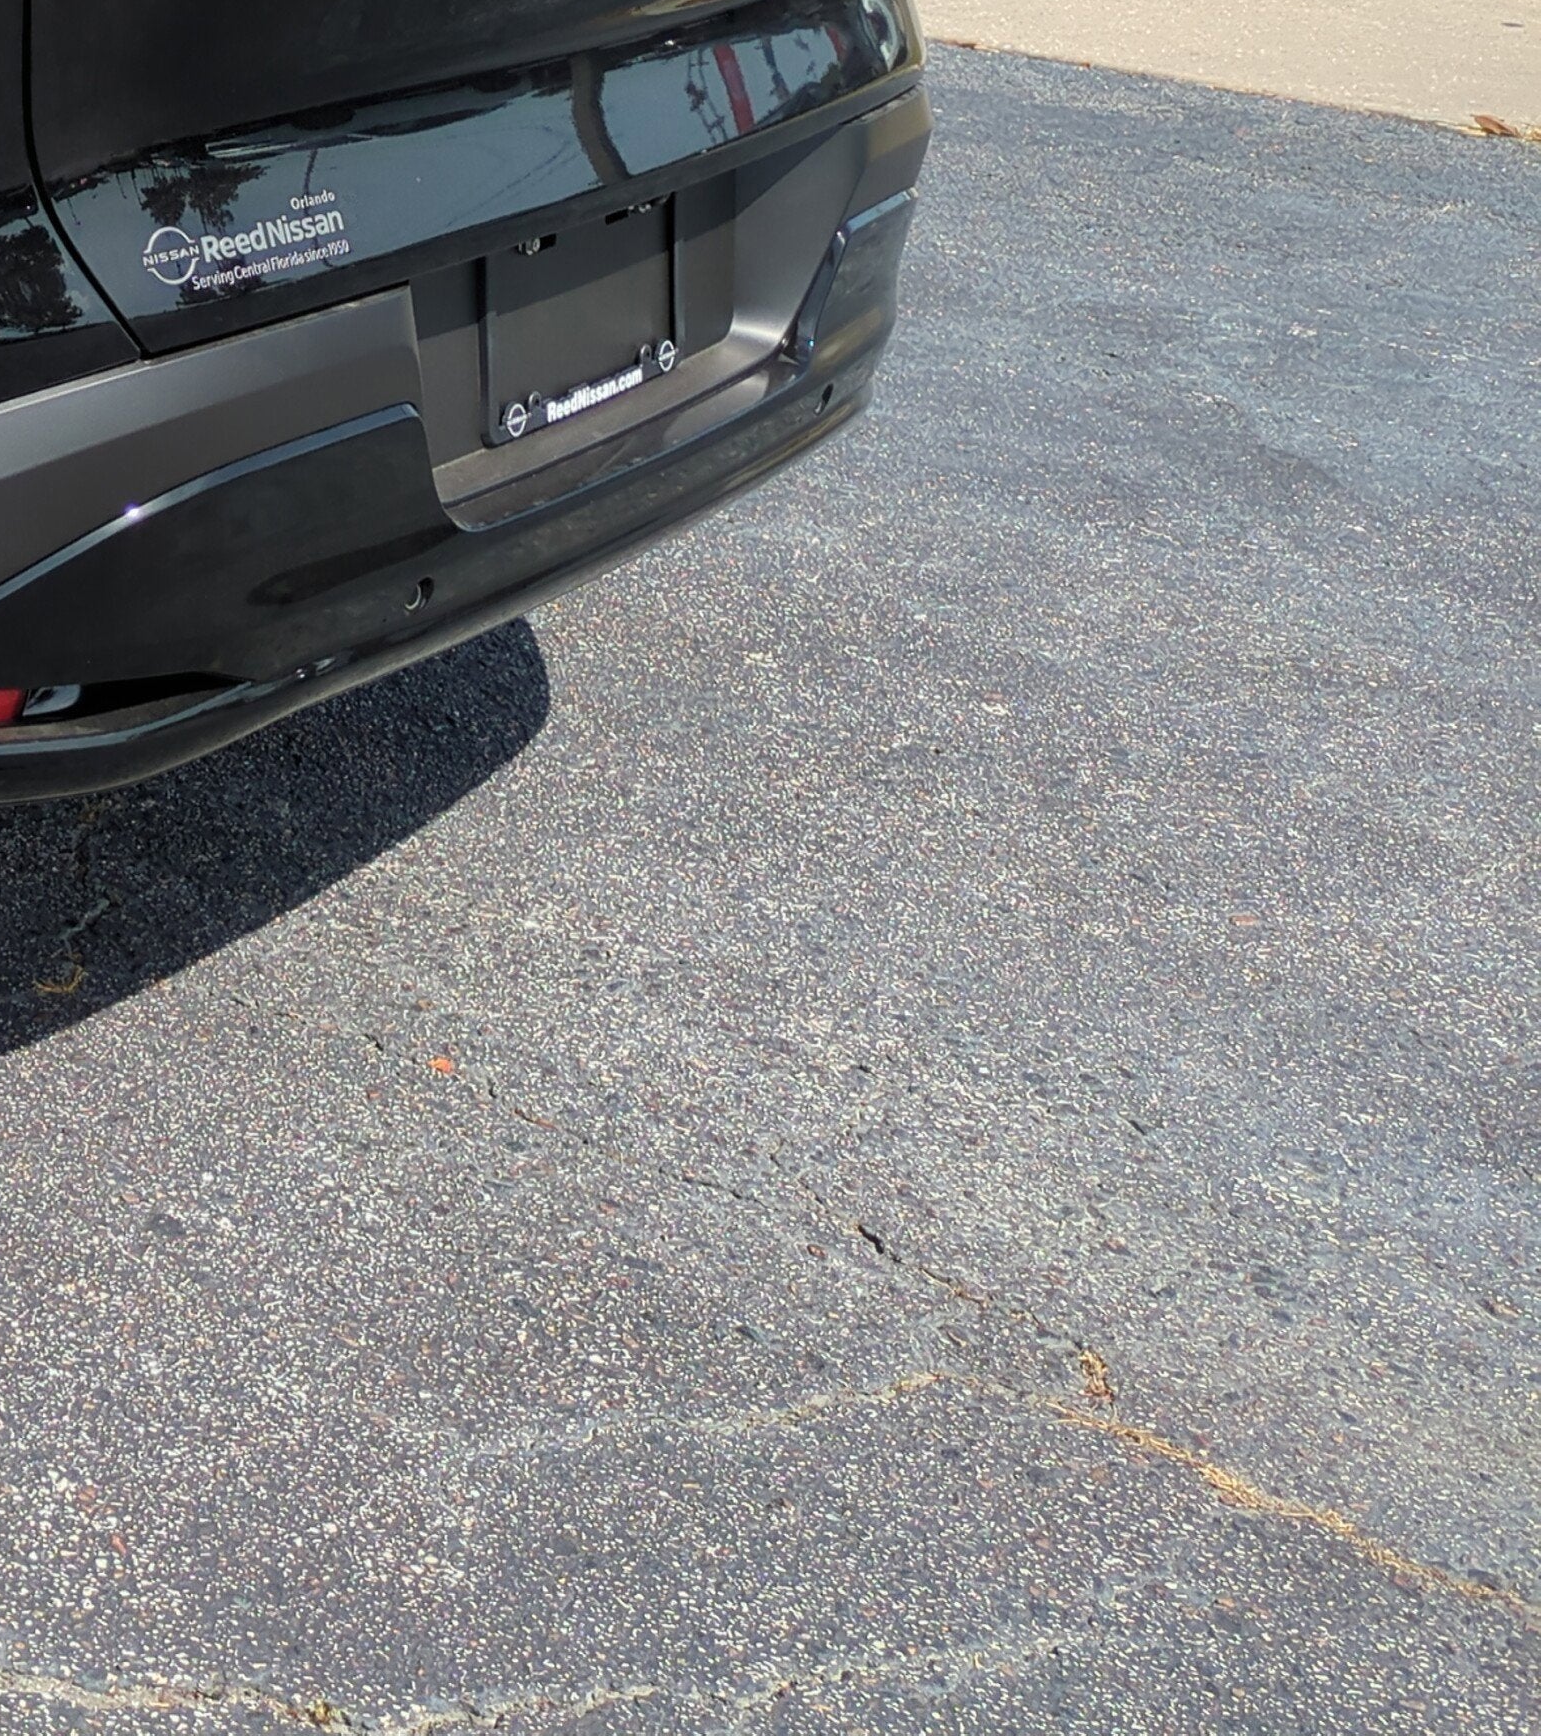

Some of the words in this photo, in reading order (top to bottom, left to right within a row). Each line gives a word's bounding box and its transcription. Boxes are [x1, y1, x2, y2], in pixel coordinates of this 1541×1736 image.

[289, 189, 337, 211] Orlando
[142, 244, 200, 267] NISSAN
[191, 270, 235, 291] Serving
[234, 259, 272, 281] Central
[271, 250, 306, 272] Florida
[546, 366, 644, 423] ReedNissan.com
